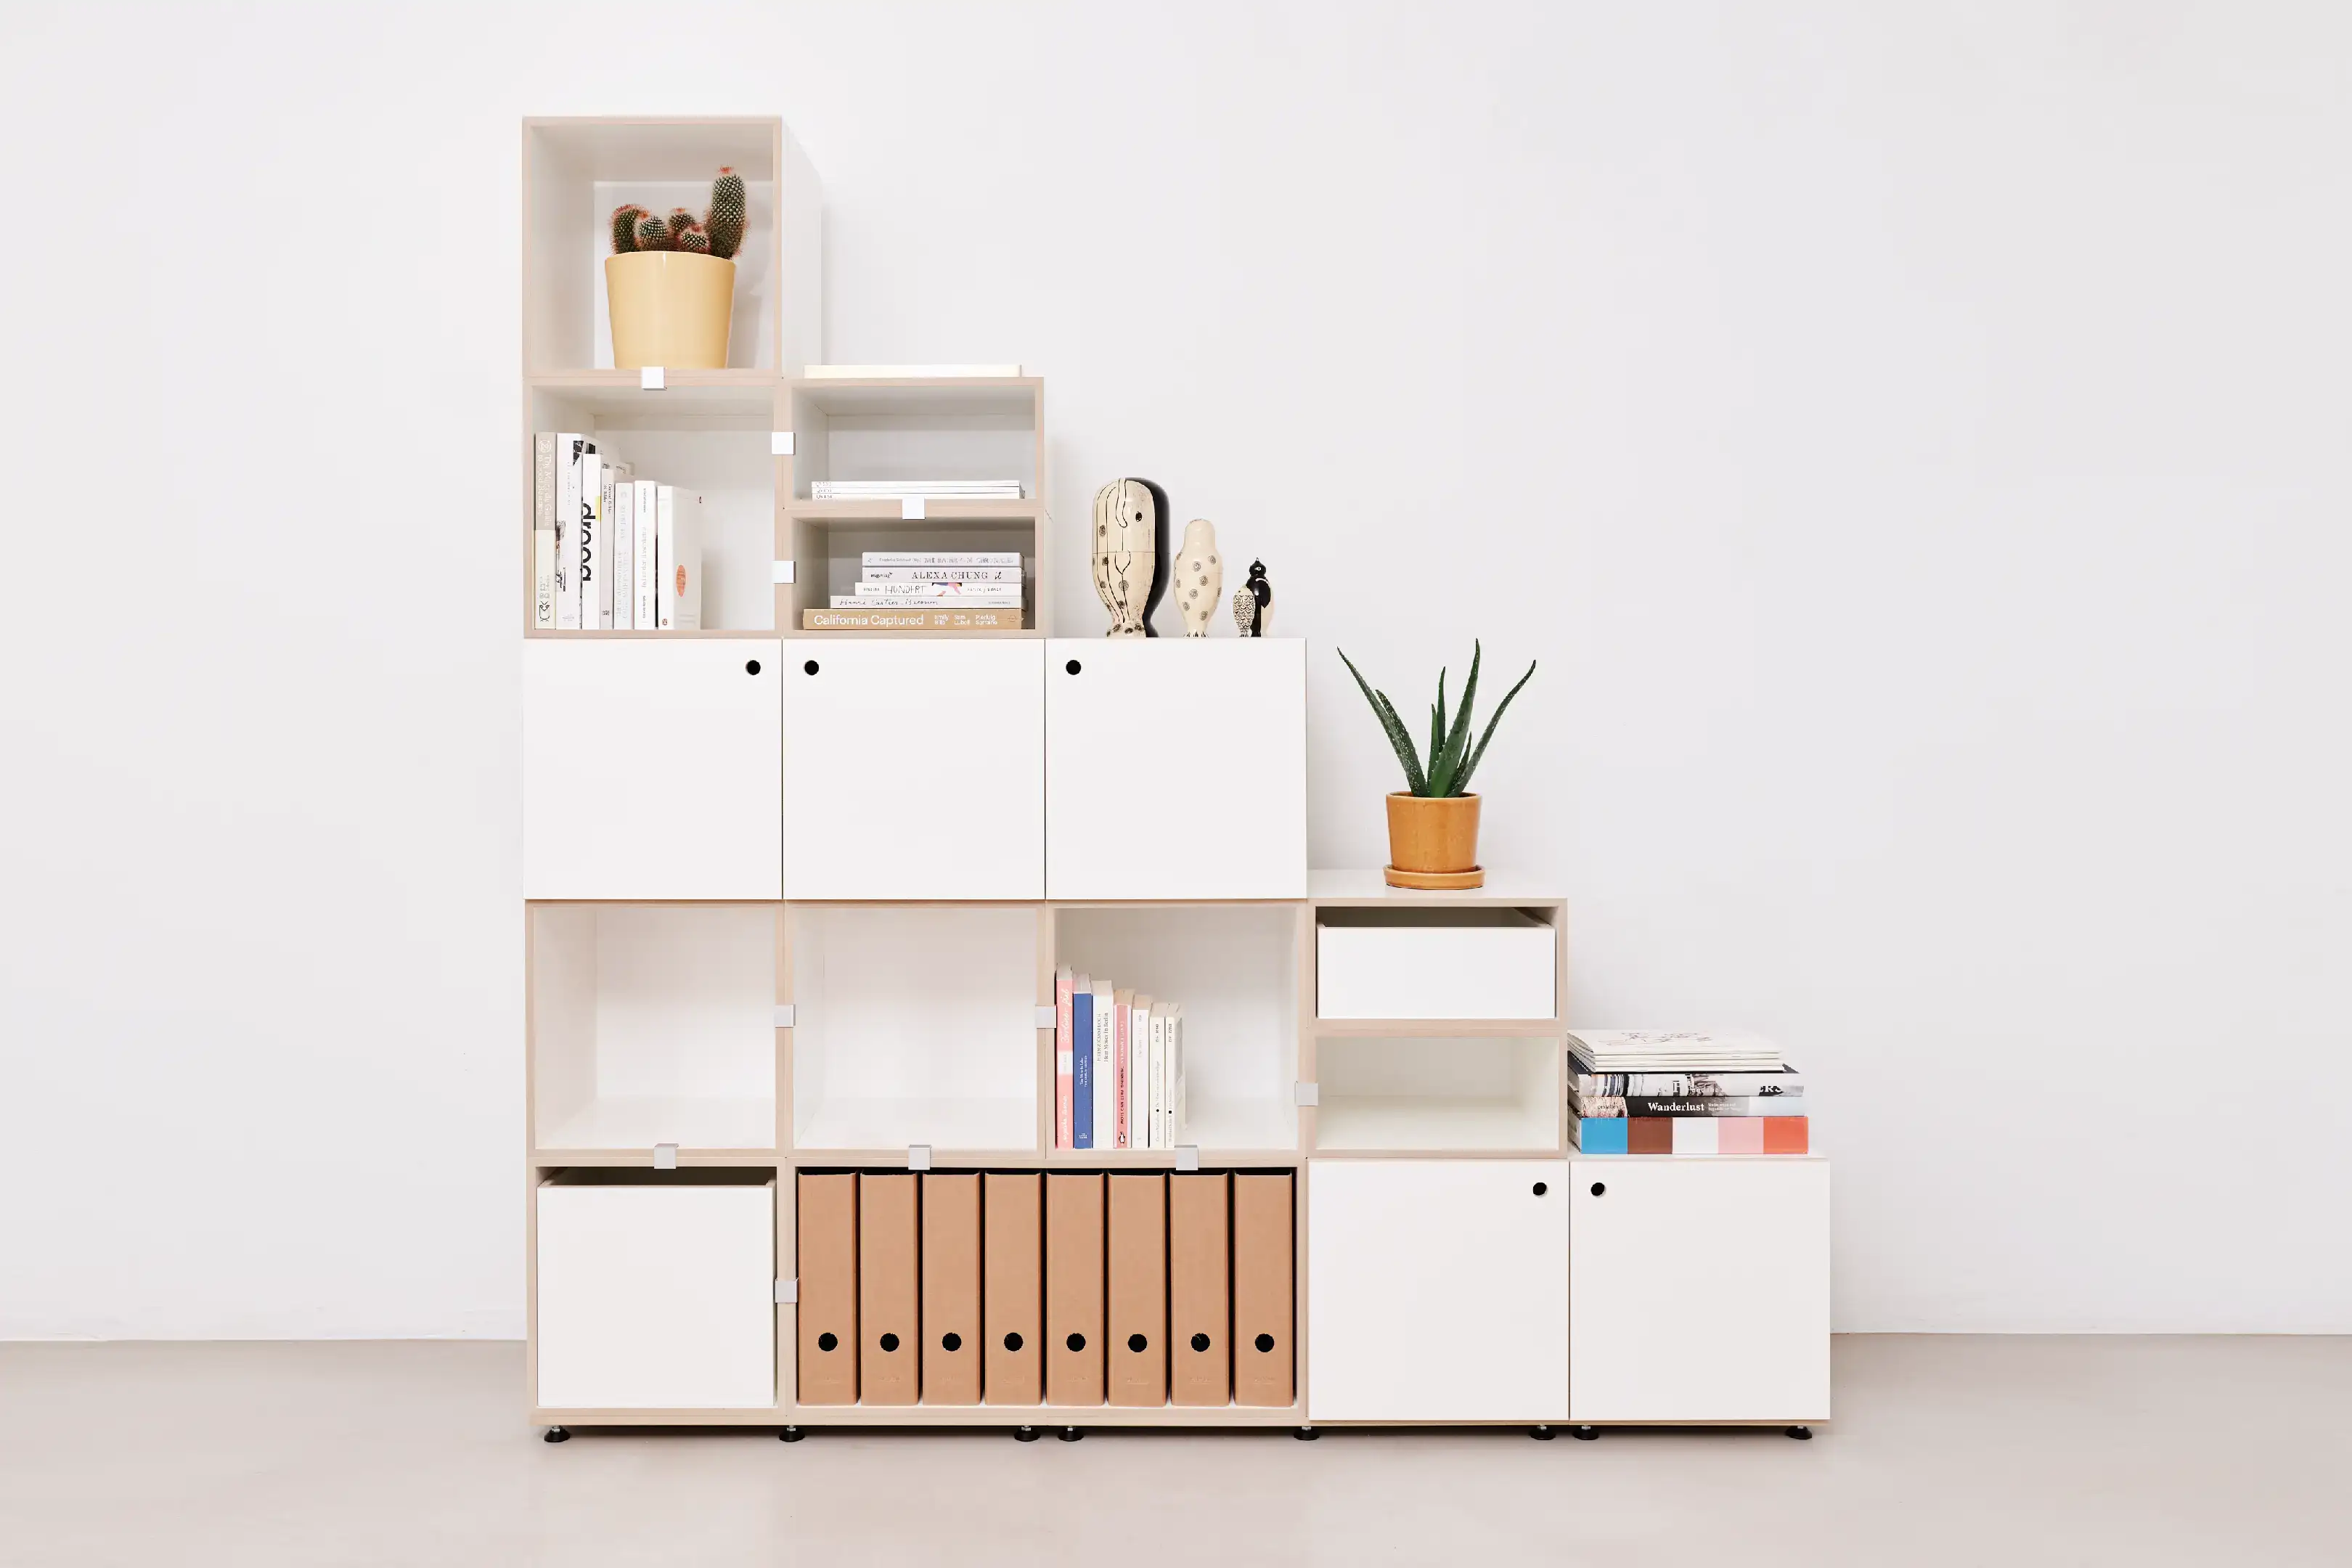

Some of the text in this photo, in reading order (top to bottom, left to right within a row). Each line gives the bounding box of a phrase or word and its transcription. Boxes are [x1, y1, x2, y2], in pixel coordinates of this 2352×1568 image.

[814, 614, 924, 627] California Captured
[1648, 1102, 1704, 1111] Wanderlust
